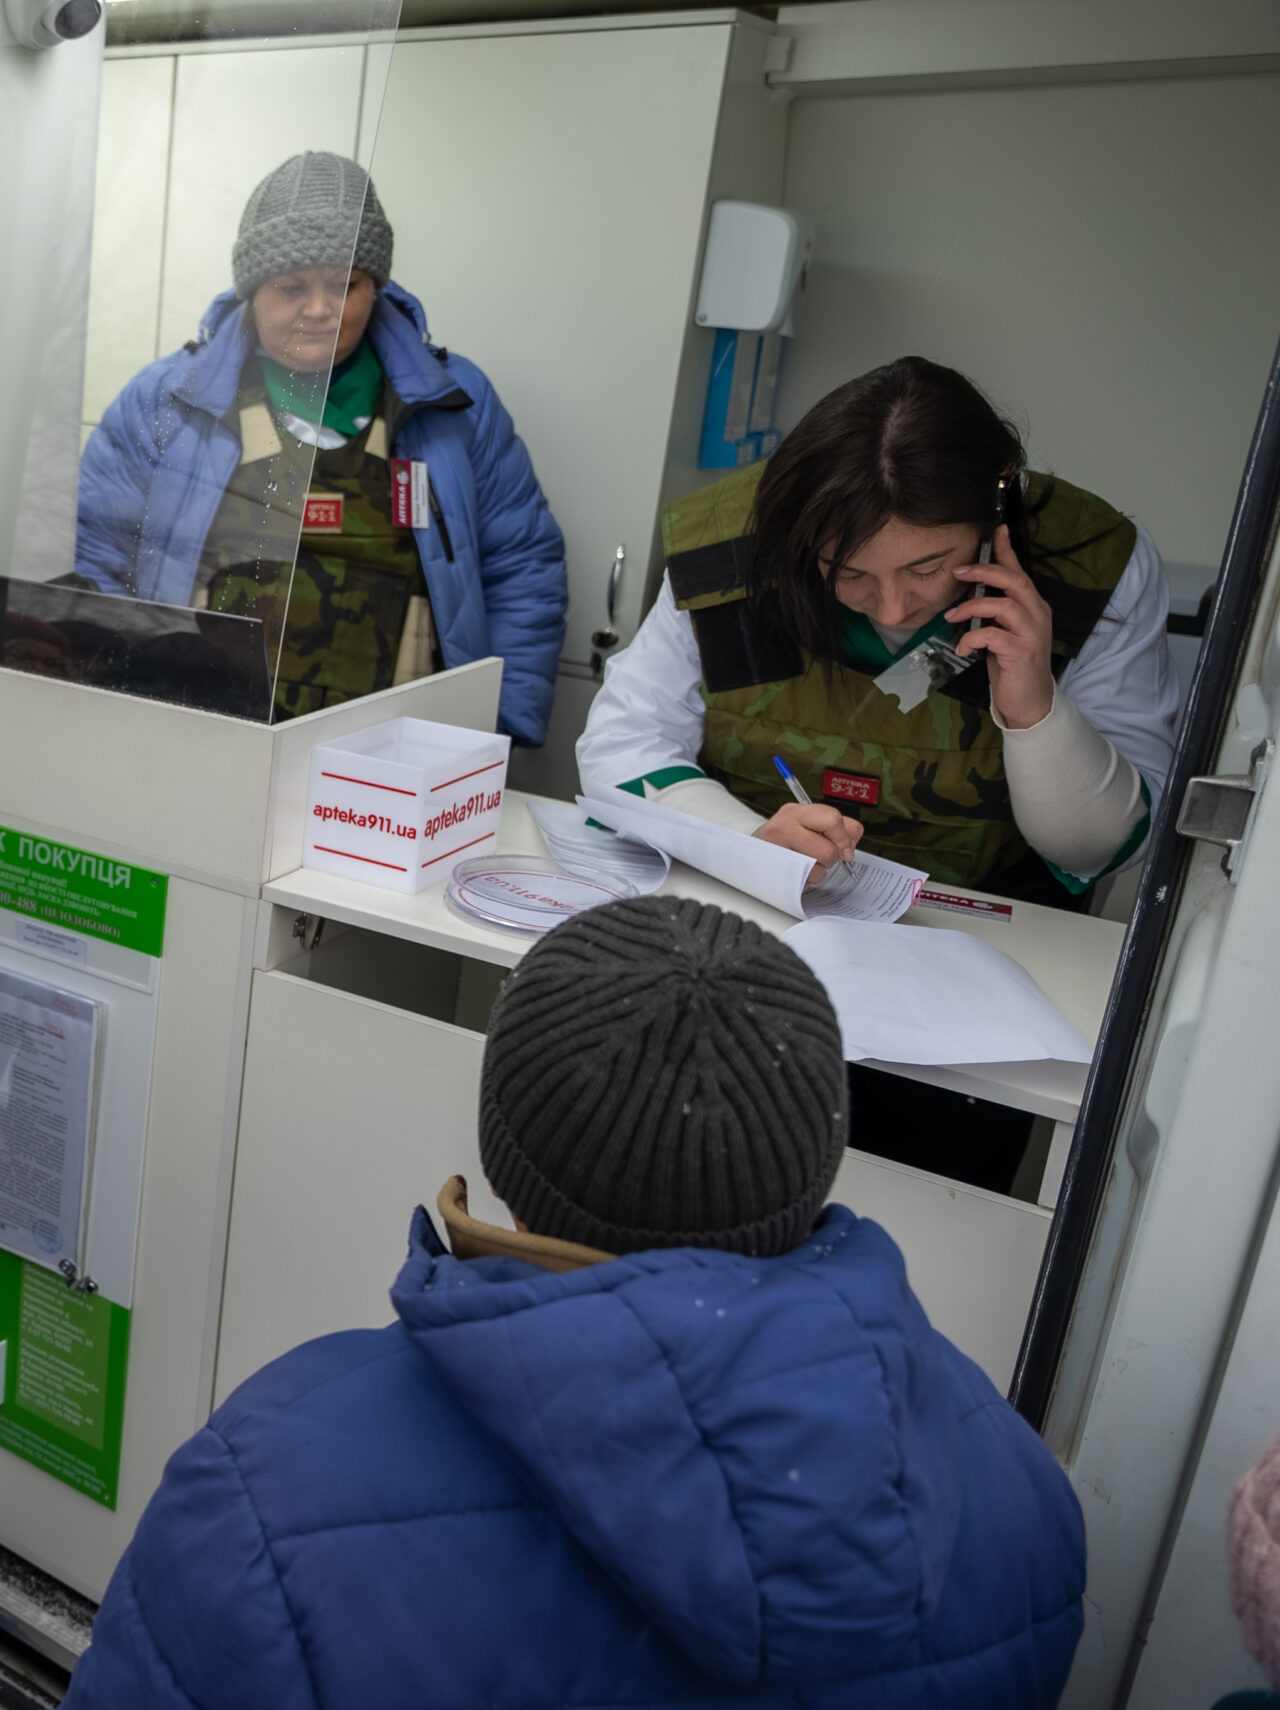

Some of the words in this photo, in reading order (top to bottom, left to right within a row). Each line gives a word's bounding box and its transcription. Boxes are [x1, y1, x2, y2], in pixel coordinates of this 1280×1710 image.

[313, 803, 417, 840] apteka911.ua
[423, 790, 501, 841] apteka911.ua
[18, 838, 132, 890] ПОКУПЦЯ
